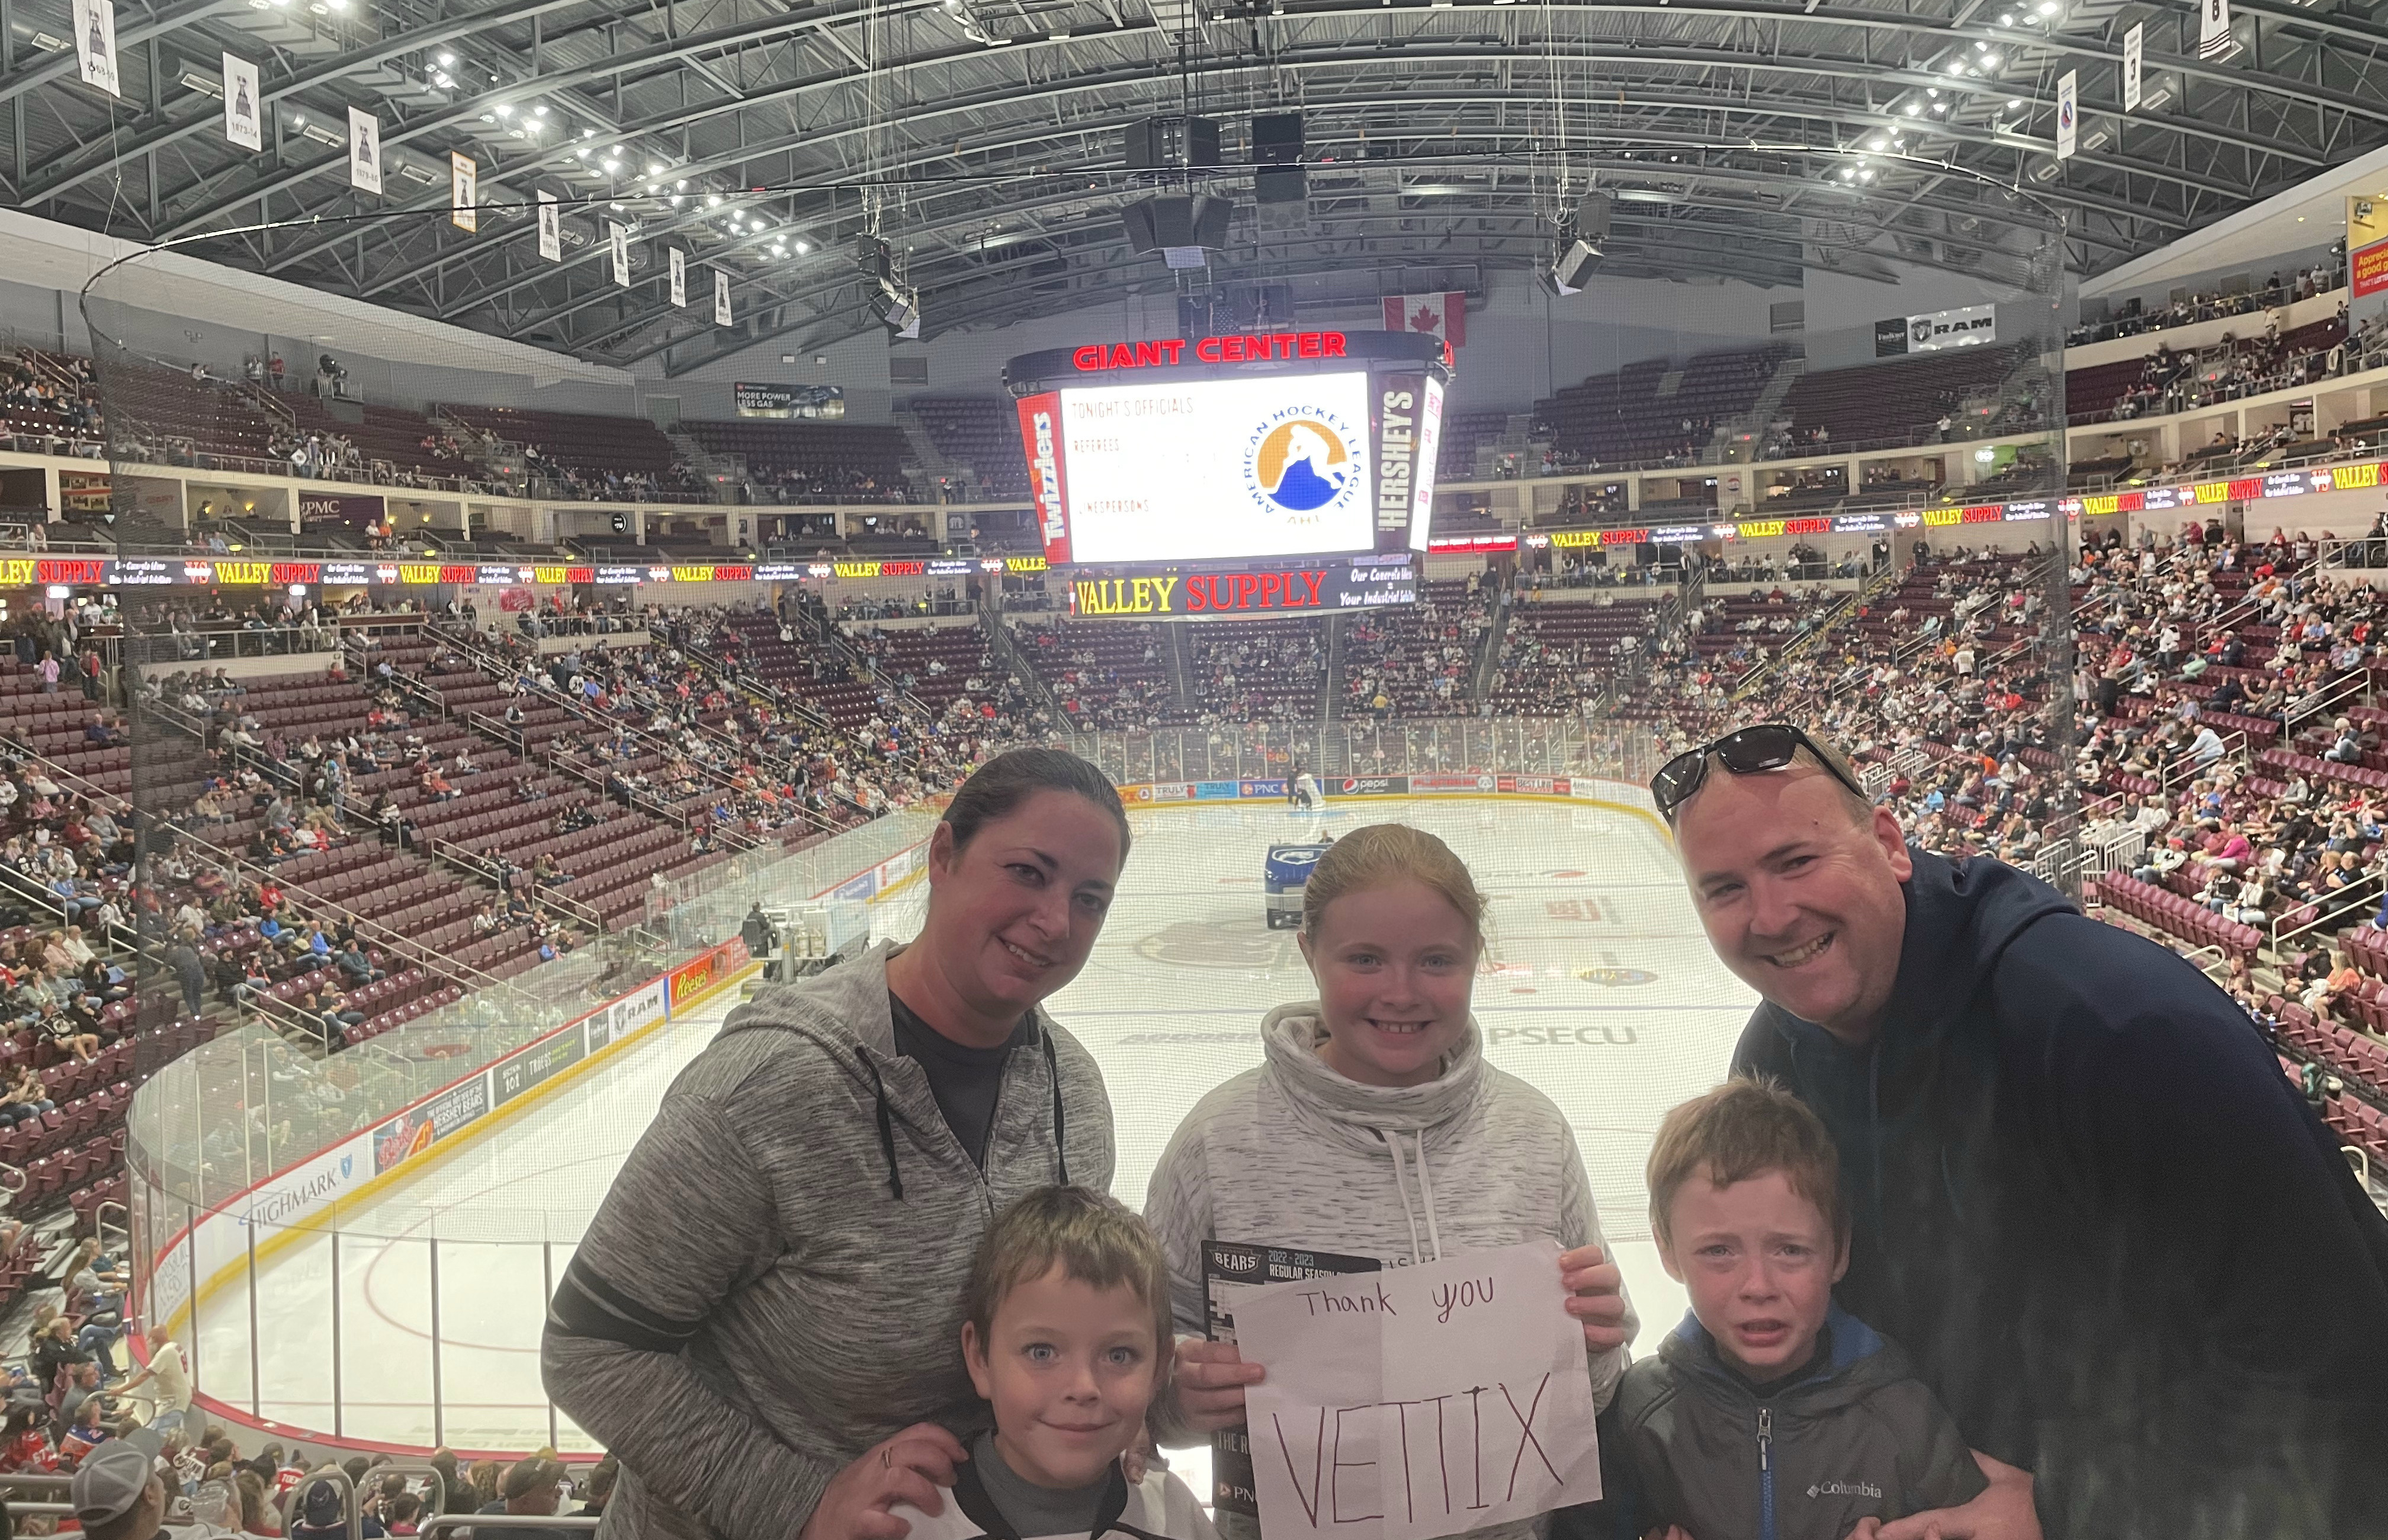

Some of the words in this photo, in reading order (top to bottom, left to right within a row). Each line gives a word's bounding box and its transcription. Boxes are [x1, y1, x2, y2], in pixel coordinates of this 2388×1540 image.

[2362, 263, 2382, 280] good
[1934, 317, 1992, 335] RAM
[1073, 339, 1186, 371] GIANT
[1196, 331, 1347, 363] CENTER
[737, 392, 761, 401] MORE
[762, 393, 791, 402] POWER
[737, 399, 756, 408] LESS
[1071, 400, 1131, 419] TONIGHTS
[1135, 397, 1194, 417] OFFICIALS
[1244, 422, 1275, 514] AMERICAN
[1272, 405, 1350, 432] HOCKEY
[1333, 438, 1362, 511] LEAGUE
[1378, 391, 1414, 528] HERSHEY'S
[2332, 463, 2380, 490] VALLEY
[2194, 481, 2230, 504] VALLEY
[2228, 477, 2264, 501] SUPPLY
[1079, 499, 1150, 515] INESPERSONS
[2082, 494, 2119, 515] VALLEY
[2119, 492, 2145, 512] SUPPLY
[1922, 508, 1964, 527] VALLEY
[1963, 505, 2004, 524] SUPPLY
[1738, 521, 1786, 538] VALLEY
[1786, 518, 1832, 535] SUPPLY
[1551, 532, 1601, 548] VALLEY
[1601, 530, 1649, 545] SUPPLY
[37, 560, 104, 585] SUPPLY
[214, 562, 271, 584] VALLEY
[272, 563, 320, 584] SUPPLY
[399, 564, 441, 583] VALLEY
[441, 566, 477, 584] SUPPLY
[672, 566, 715, 582] VALLEY
[715, 566, 753, 581] SUPPLY
[833, 562, 881, 578] VALLEY
[882, 562, 925, 576] SUPPLY
[1007, 557, 1045, 572] VALLE
[534, 567, 567, 583] VALLEY
[567, 567, 594, 583] SUPPLY
[1351, 567, 1369, 583] Our
[1076, 576, 1179, 615] VALLEY
[1186, 571, 1328, 612] SUPPLY
[1339, 591, 1362, 607] Your
[1156, 786, 1185, 795] TRULY
[1254, 784, 1279, 794] PNC
[1359, 778, 1389, 791] pepsi
[627, 994, 658, 1020] RAM
[1488, 1025, 1638, 1045] PSECU
[506, 1073, 520, 1093] 101
[252, 1170, 337, 1229] HIGHMARK
[1215, 1252, 1257, 1272] BEARS
[1268, 1249, 1288, 1264] 2022
[1295, 1253, 1315, 1267] 2023
[1269, 1263, 1304, 1281] REGULAR
[1296, 1281, 1398, 1317] Thank
[1217, 1430, 1238, 1452] THE
[1272, 1371, 1565, 1529] VETTIX
[1234, 1486, 1254, 1503] PN
[1820, 1480, 1883, 1499] Columbia
